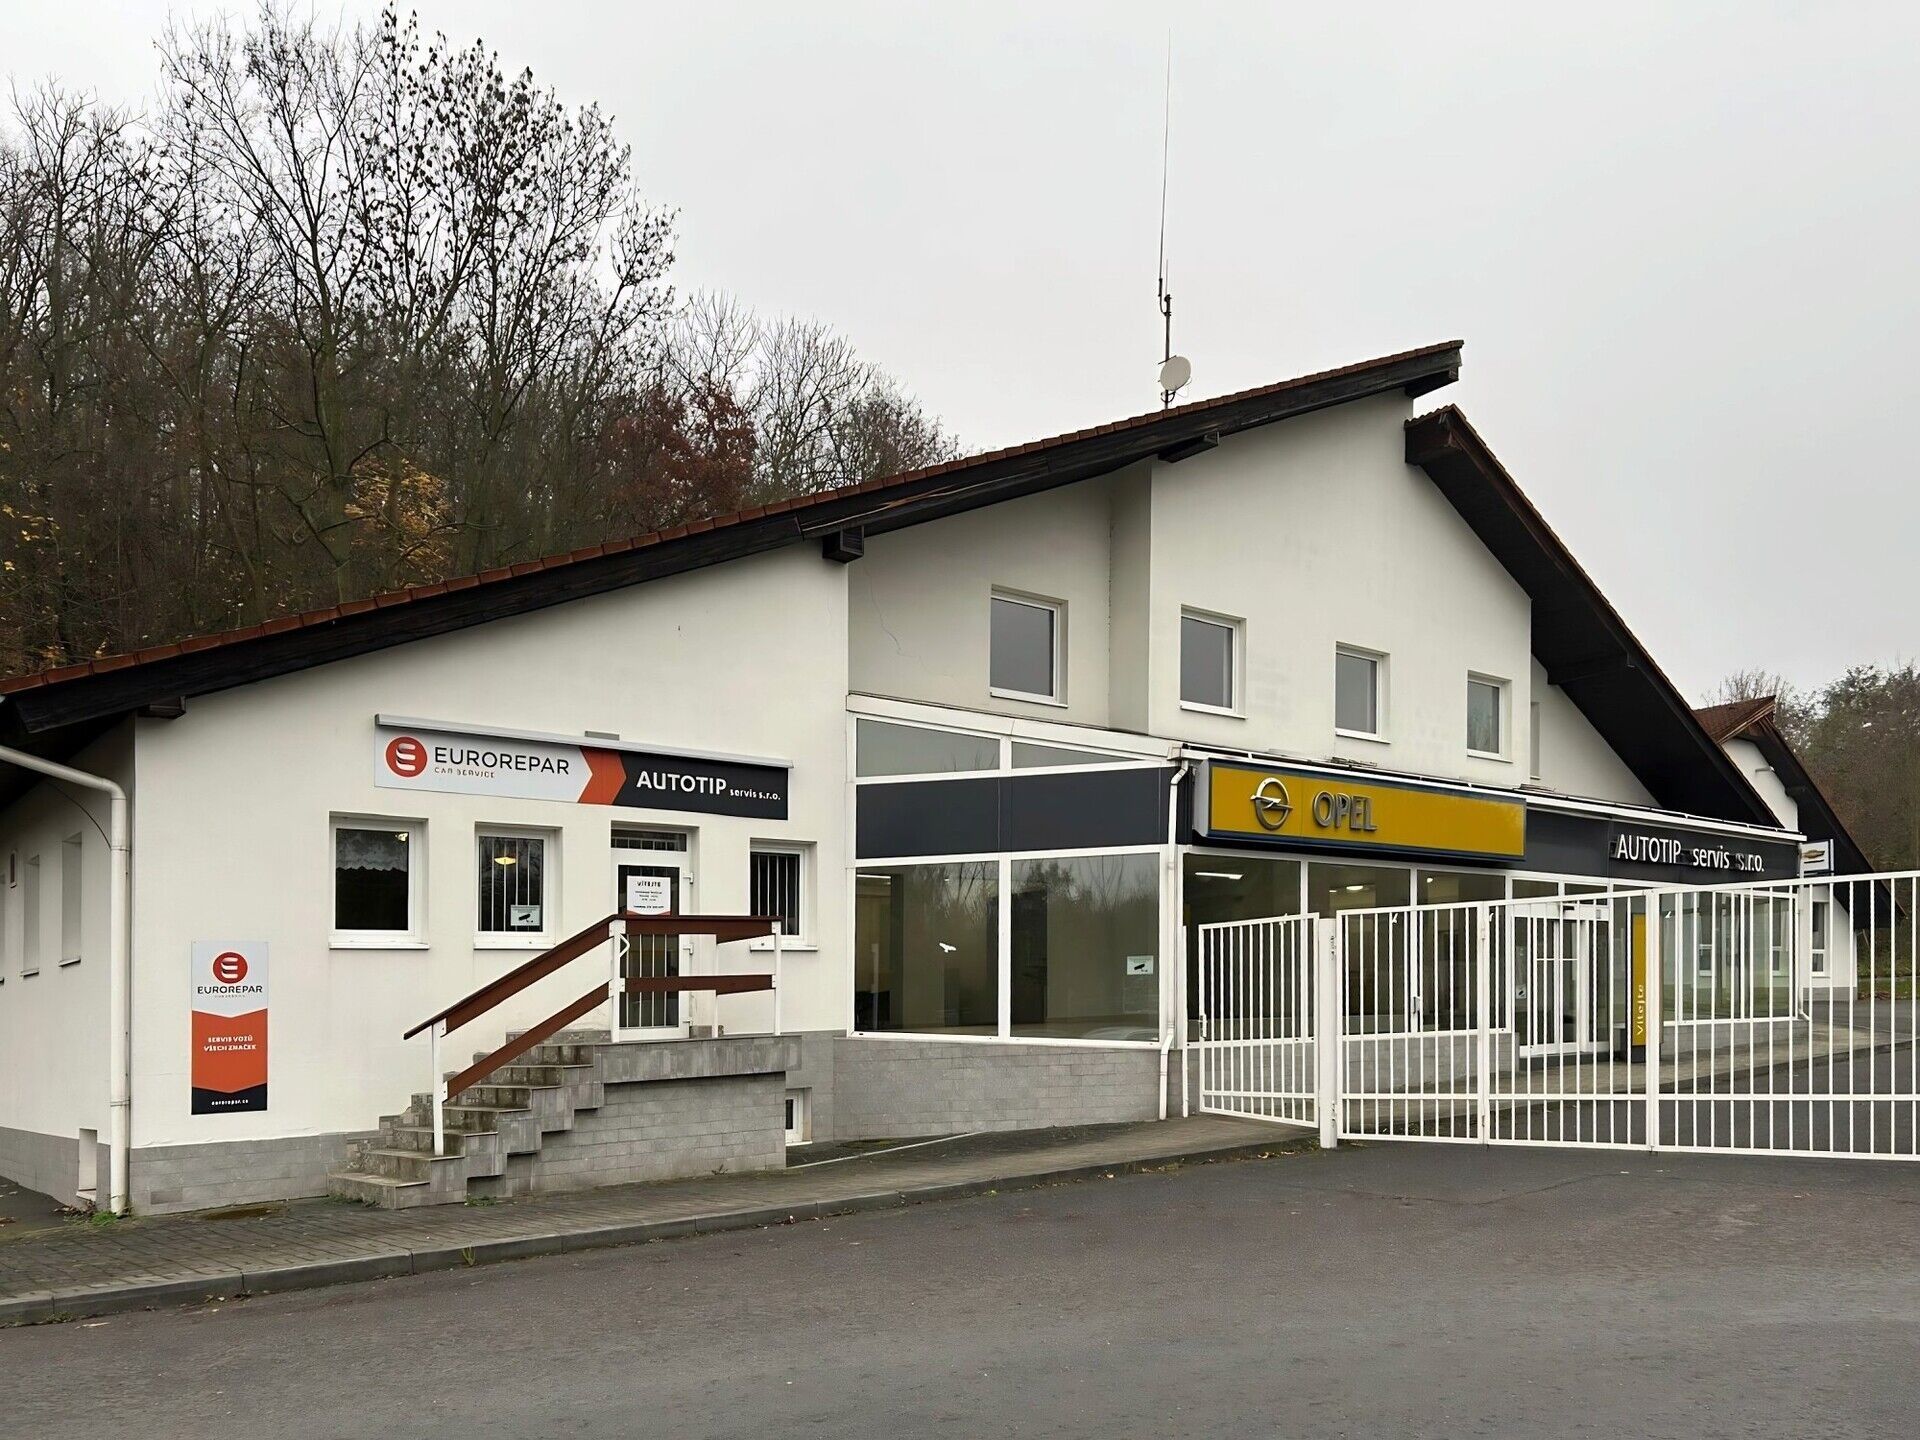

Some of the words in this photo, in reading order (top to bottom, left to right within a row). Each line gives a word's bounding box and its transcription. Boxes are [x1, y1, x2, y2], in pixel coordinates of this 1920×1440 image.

[434, 746, 569, 775] EUROREPAR
[636, 770, 727, 795] AUTOTIP
[729, 788, 757, 799] servis
[758, 791, 781, 801] s.r.o.
[1313, 790, 1378, 832] OPEL
[1616, 833, 1682, 864] AUTOTIP
[1692, 844, 1730, 869] servis
[1737, 852, 1765, 872] s.r.o.
[197, 985, 263, 994] EUROREPAR
